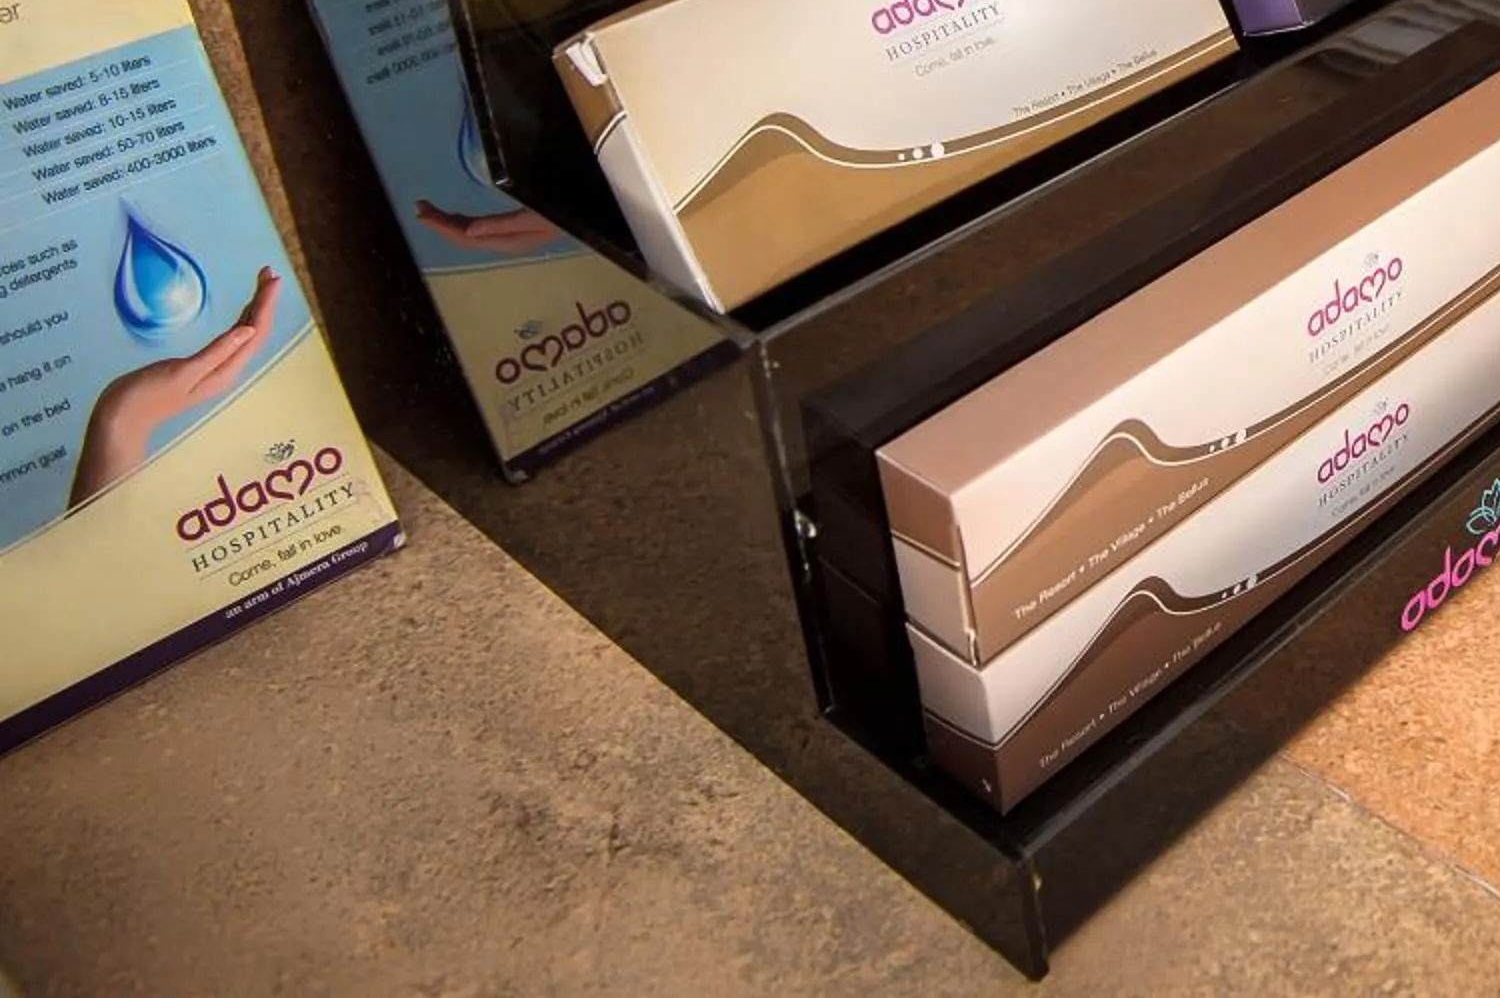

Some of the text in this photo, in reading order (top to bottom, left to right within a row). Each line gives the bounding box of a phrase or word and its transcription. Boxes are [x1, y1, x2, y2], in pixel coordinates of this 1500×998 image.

[885, 3, 1001, 62] HOSPITALITY
[3, 54, 152, 111] Water saved: 5-10 liters
[12, 77, 161, 135] Water saved: 8-15 liters
[1012, 105, 1031, 118] The
[1066, 83, 1083, 96] The
[1116, 60, 1133, 74] The
[22, 97, 177, 159] Water saved: 10-15 liters
[32, 119, 186, 182] Water saved: 50-70 liters
[41, 134, 217, 205] Water saved: 400-3000 liters
[9, 258, 78, 291] detergents
[27, 245, 59, 265] such
[61, 239, 79, 253] as
[44, 310, 69, 331] you
[1307, 256, 1403, 337] adamo
[1309, 289, 1403, 364] HOSPITALITY
[7, 366, 43, 388] hang
[53, 355, 72, 370] on
[2, 398, 71, 437] on the bed
[1316, 402, 1410, 485] adamo
[38, 444, 67, 469] goal
[1318, 432, 1408, 508] HOSPITALITY
[176, 446, 343, 542] adamo
[191, 481, 355, 574] HOSPITALITY
[225, 539, 370, 620] an arm of Ajmera Group
[228, 556, 277, 588] Come,
[278, 544, 297, 563] fall
[299, 537, 313, 553] in
[1014, 599, 1037, 620] The
[1038, 571, 1077, 604] Resort
[1087, 549, 1110, 568] The
[1110, 522, 1147, 553] Village
[1156, 500, 1176, 519] The
[1040, 749, 1060, 768] The
[1061, 718, 1097, 751] Resort
[1107, 695, 1128, 714] The
[1128, 668, 1164, 697] Village
[1172, 644, 1192, 663] The
